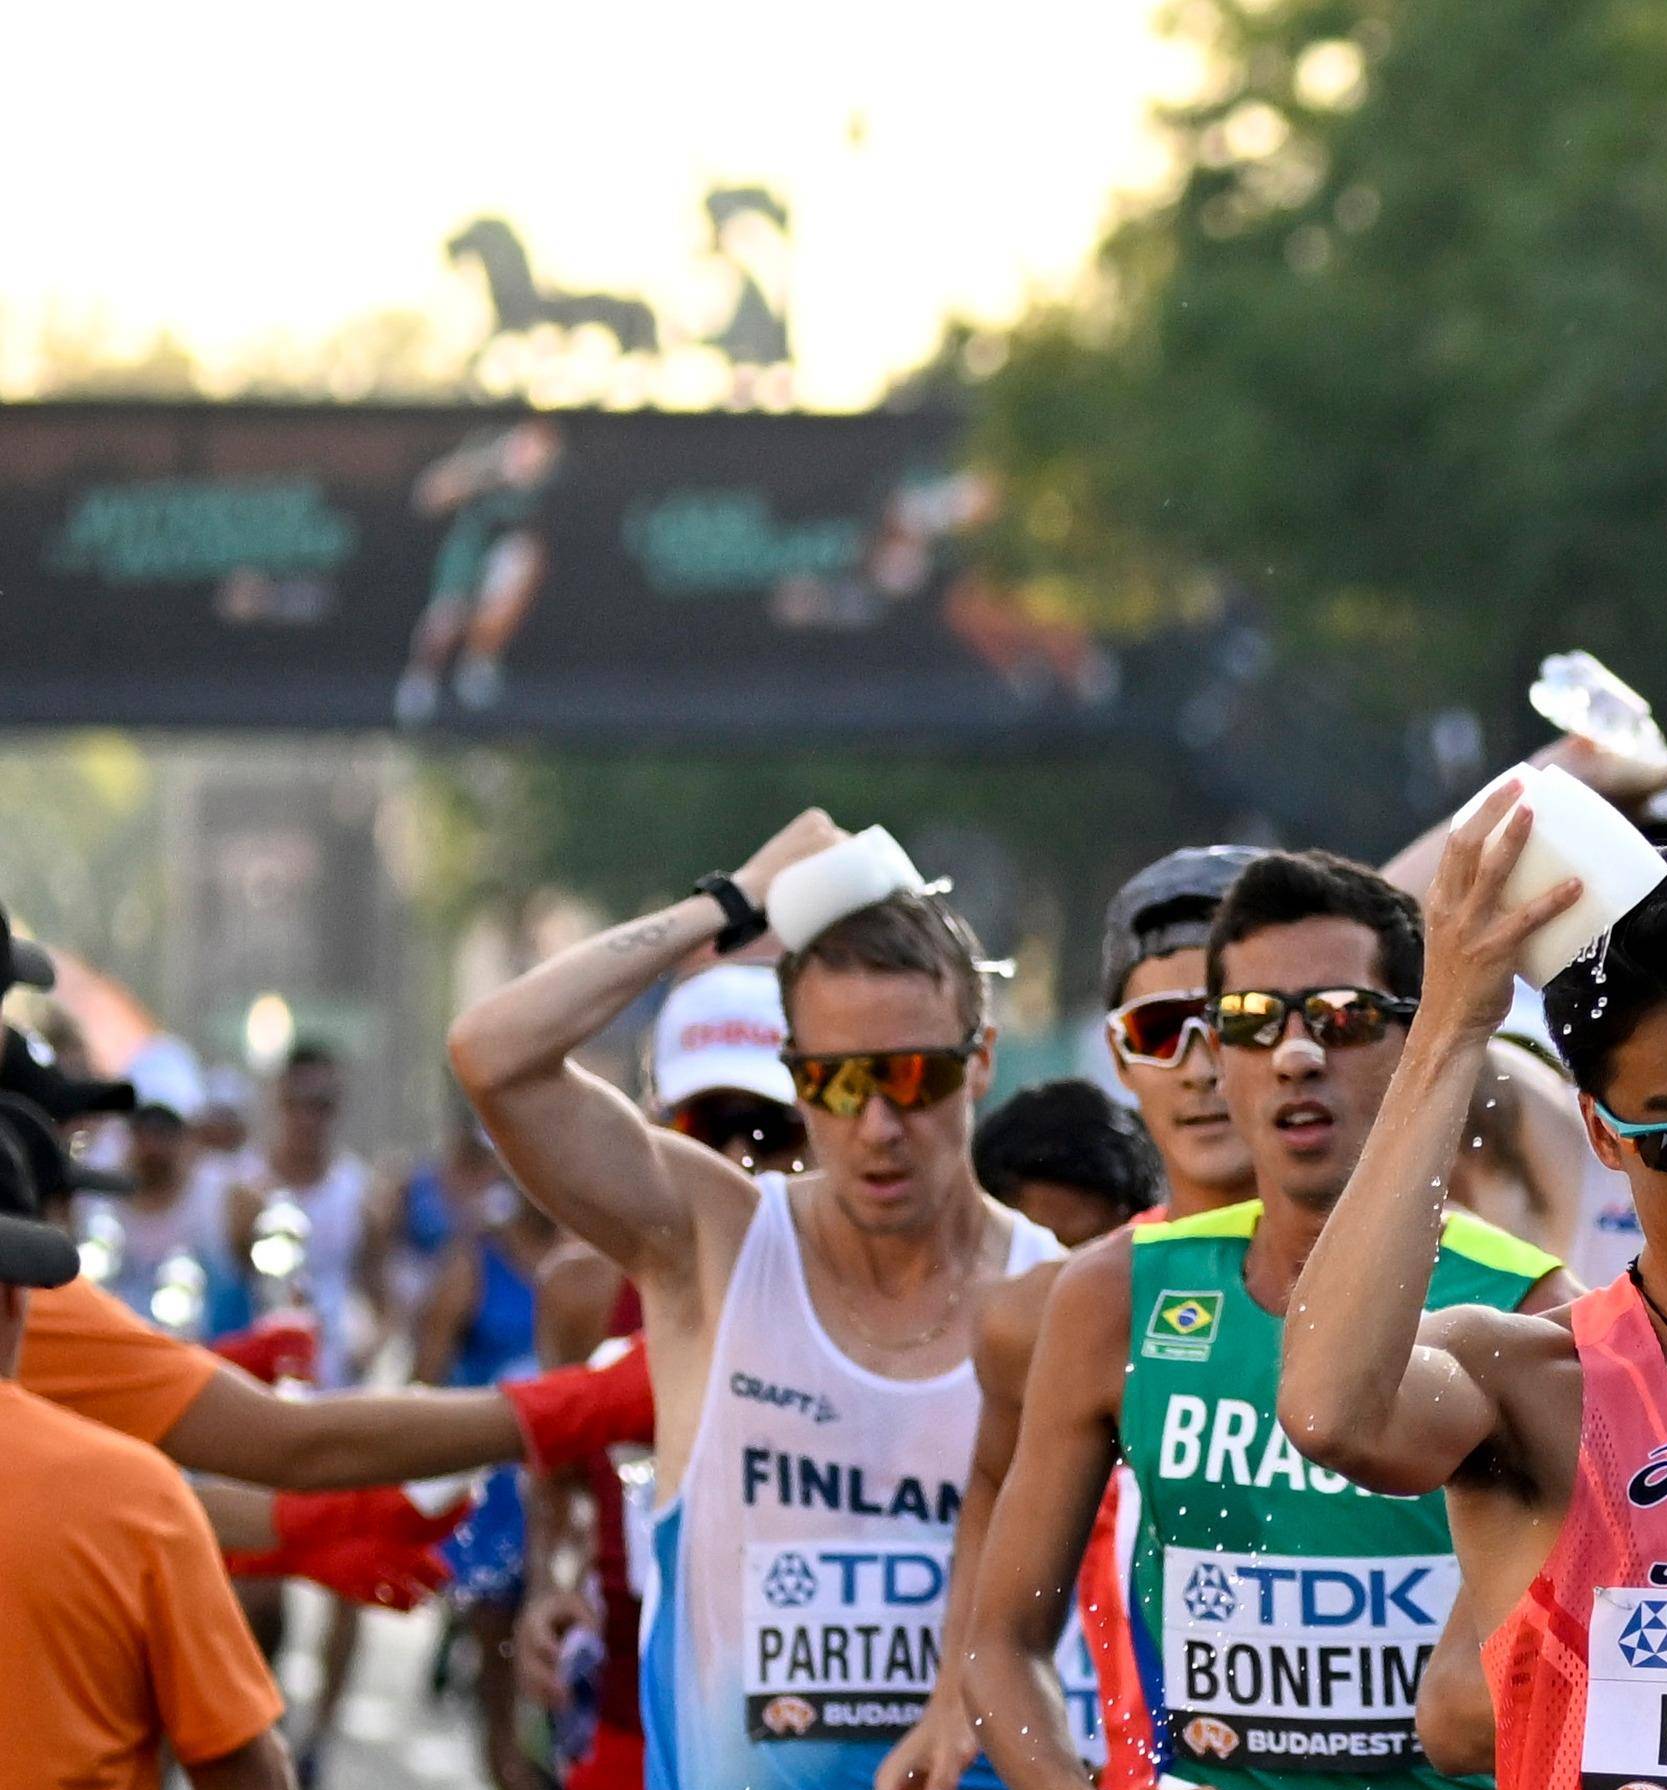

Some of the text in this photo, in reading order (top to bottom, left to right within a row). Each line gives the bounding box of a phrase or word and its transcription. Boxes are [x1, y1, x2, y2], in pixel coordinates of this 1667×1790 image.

[730, 1371, 816, 1413] CRAFT
[1159, 1394, 1420, 1501] BRA
[742, 1446, 963, 1524] FINLAN
[818, 1553, 953, 1606] TD
[1236, 1566, 1437, 1628] TDK
[822, 1701, 926, 1727] BUDAP
[1246, 1729, 1408, 1757] BUDAPEST
